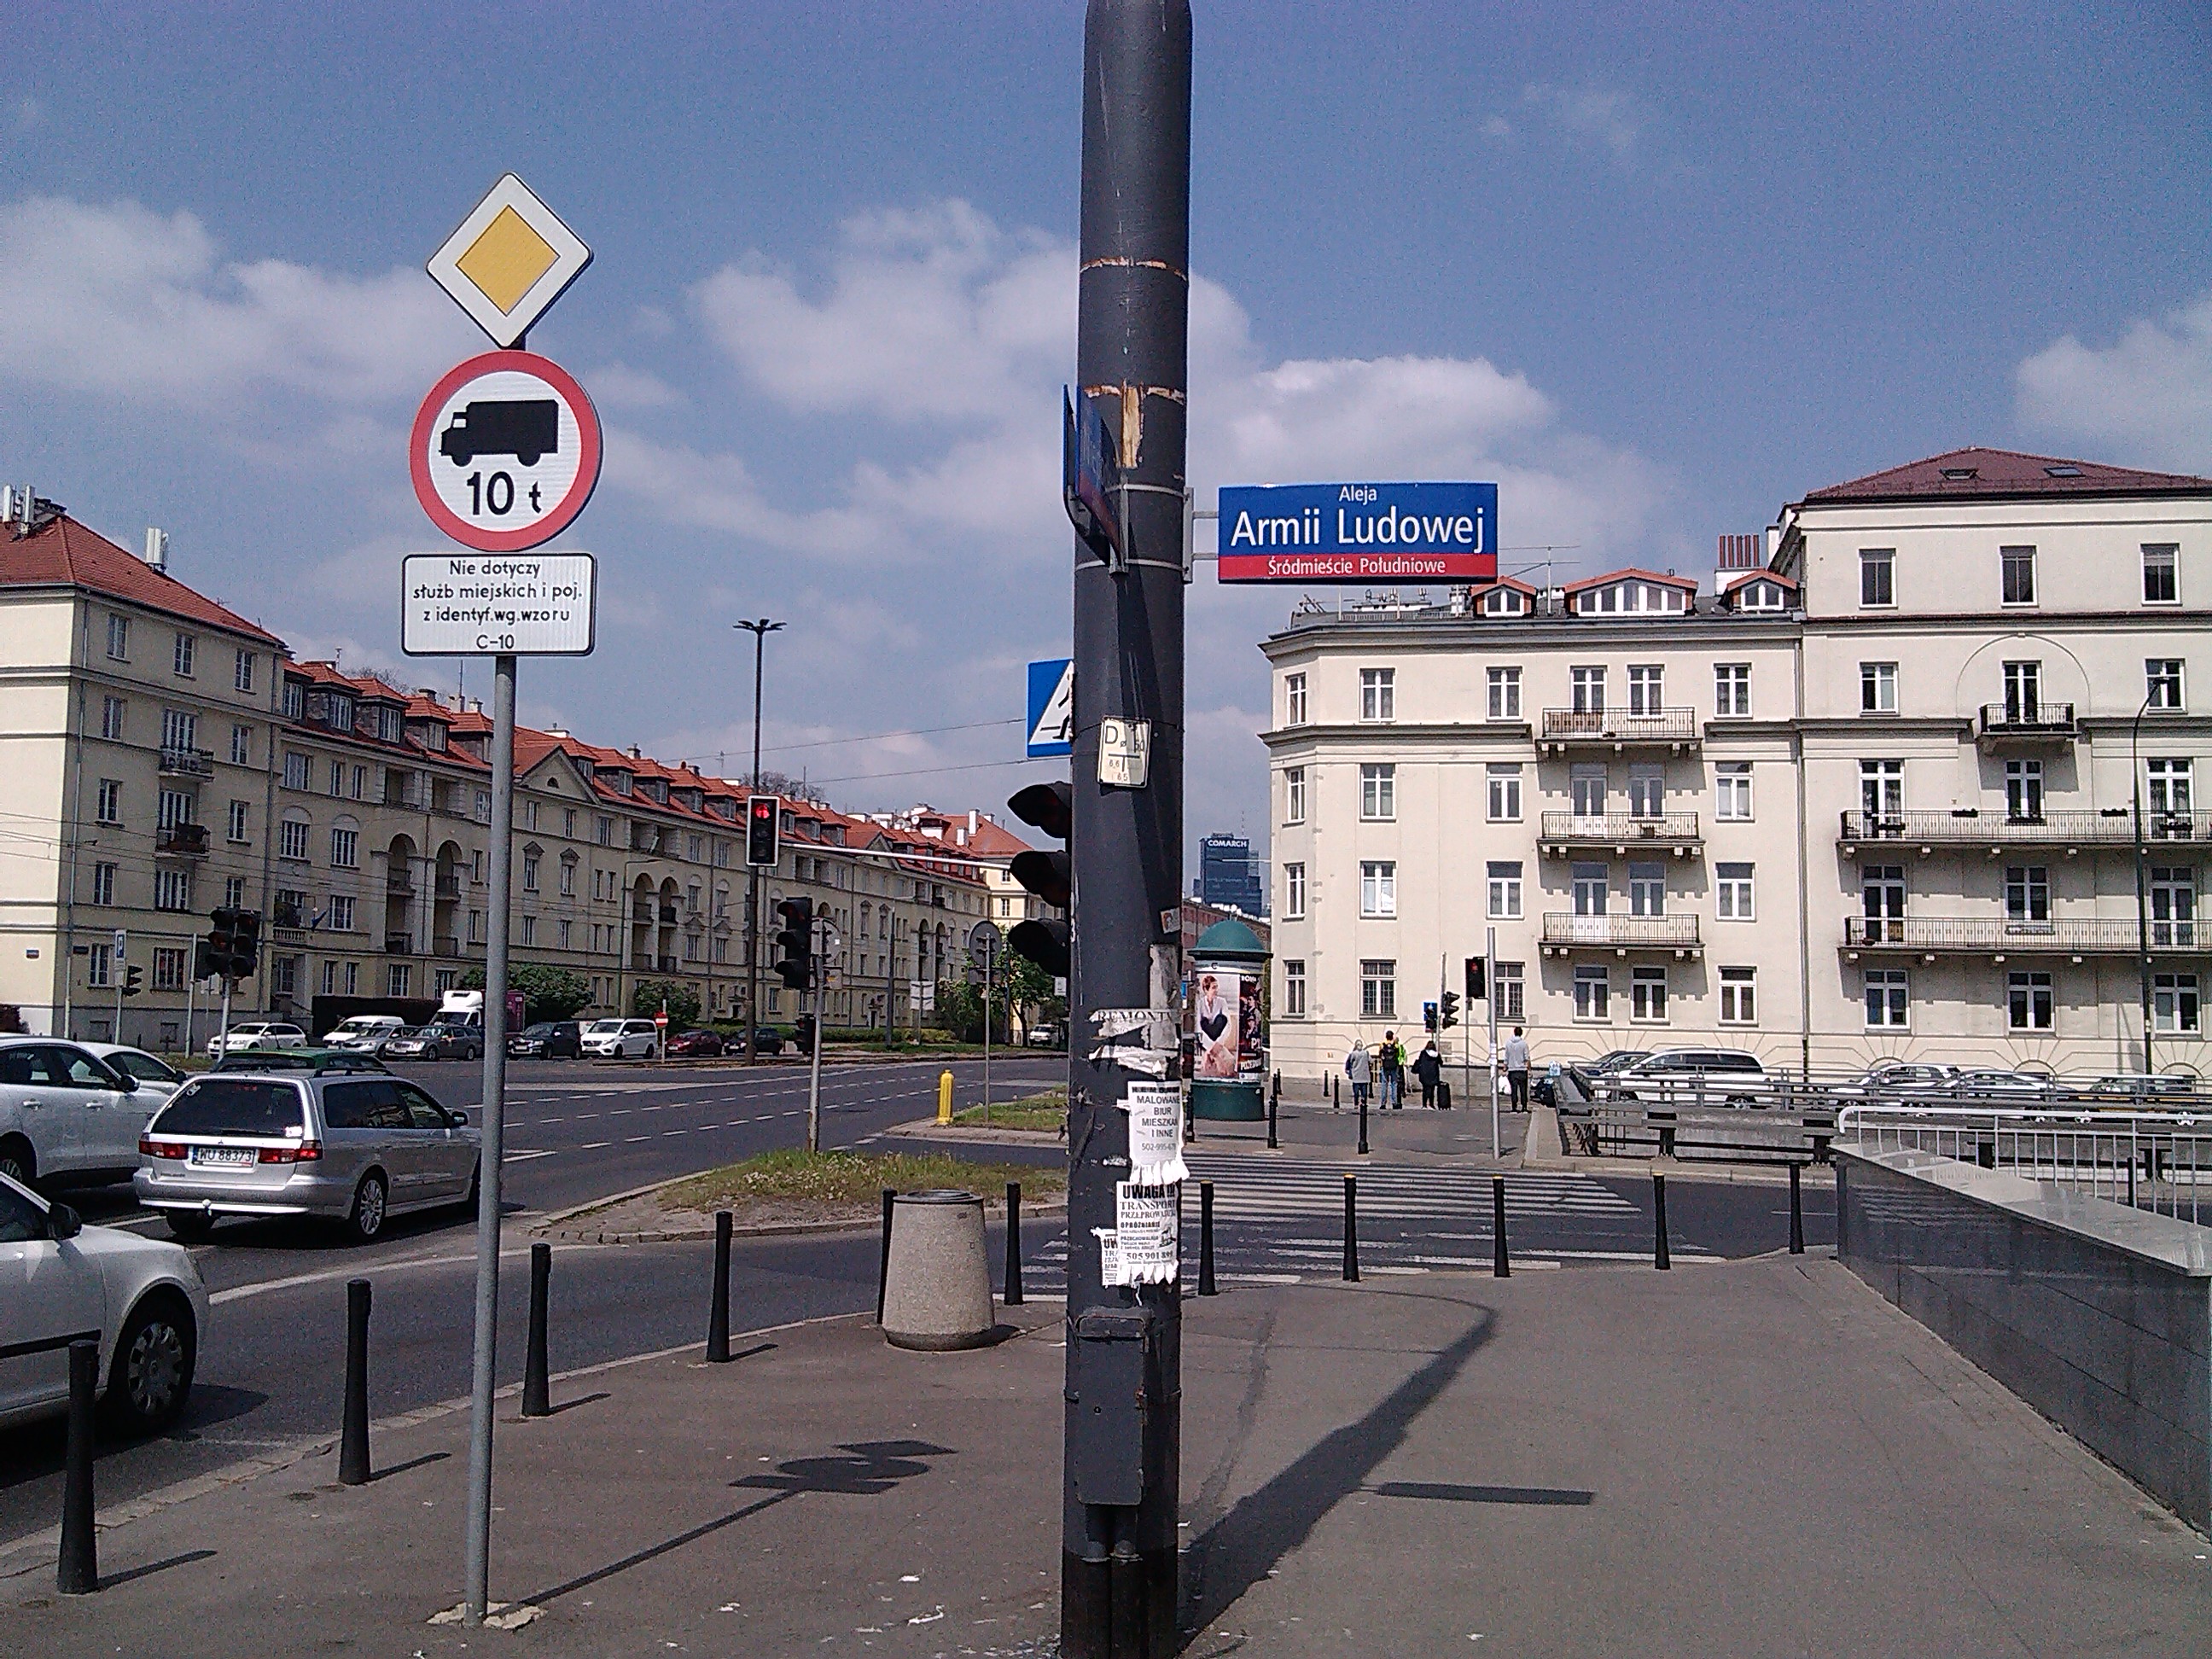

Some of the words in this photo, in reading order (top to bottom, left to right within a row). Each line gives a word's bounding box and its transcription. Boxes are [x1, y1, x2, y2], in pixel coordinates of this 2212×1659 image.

[467, 471, 515, 515] 10
[528, 480, 542, 514] t
[1338, 485, 1378, 505] Aleja
[1231, 508, 1320, 546] Armii
[1338, 505, 1484, 555] Ludowej
[450, 560, 475, 575] Nie
[481, 560, 541, 579] dotyczy
[1268, 556, 1353, 575] Śródmieście
[1359, 557, 1447, 575] Południowe
[413, 583, 454, 599] służb
[459, 582, 537, 602] miejskich
[542, 582, 546, 597] i
[552, 583, 582, 602] poj.
[423, 610, 430, 621] z
[476, 634, 515, 649] C-10
[1154, 1107, 1172, 1115] BIUR
[1156, 1129, 1173, 1138] INNE
[200, 1148, 215, 1160] WU
[218, 1150, 252, 1161] 88373
[1122, 1185, 1165, 1199] UWAGA
[1120, 1200, 1175, 1210] TRANSPORT
